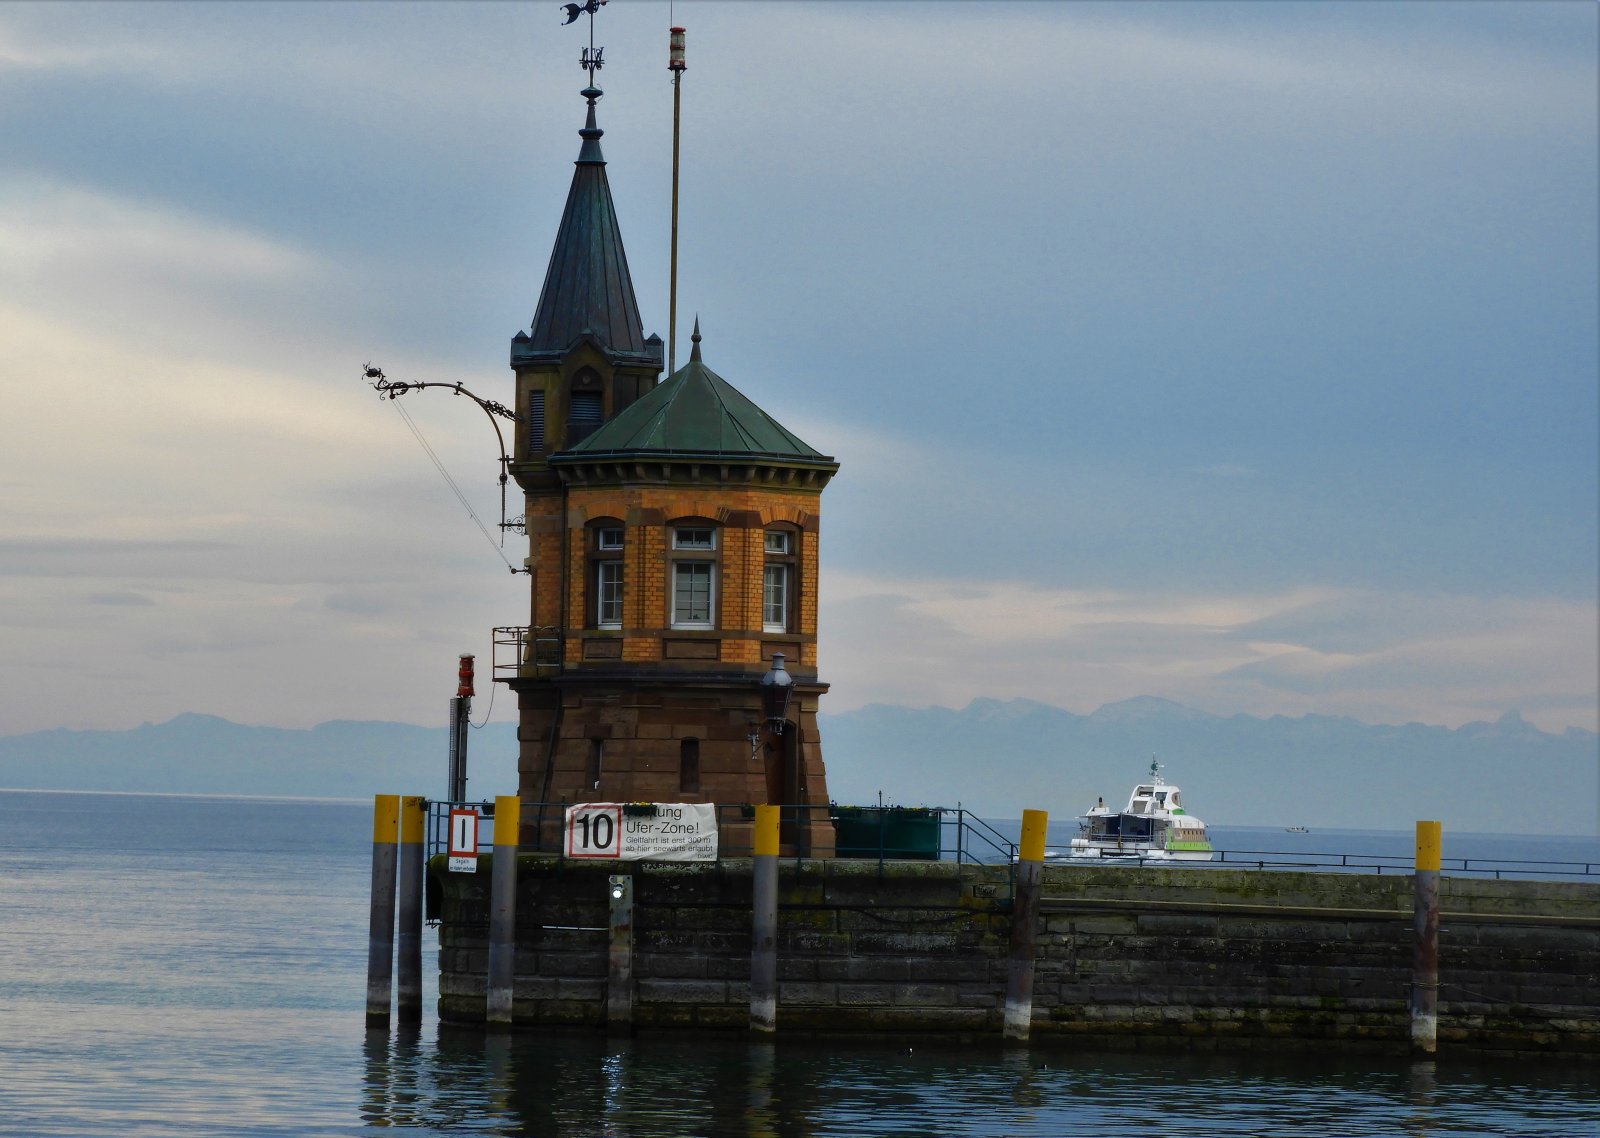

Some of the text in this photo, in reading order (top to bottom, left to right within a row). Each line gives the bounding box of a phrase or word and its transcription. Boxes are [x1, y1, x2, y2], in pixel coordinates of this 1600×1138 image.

[576, 813, 614, 849] 10
[626, 821, 700, 834] Ufer-Zone!
[625, 836, 658, 844] Gleitfahrt
[660, 836, 669, 844] ist
